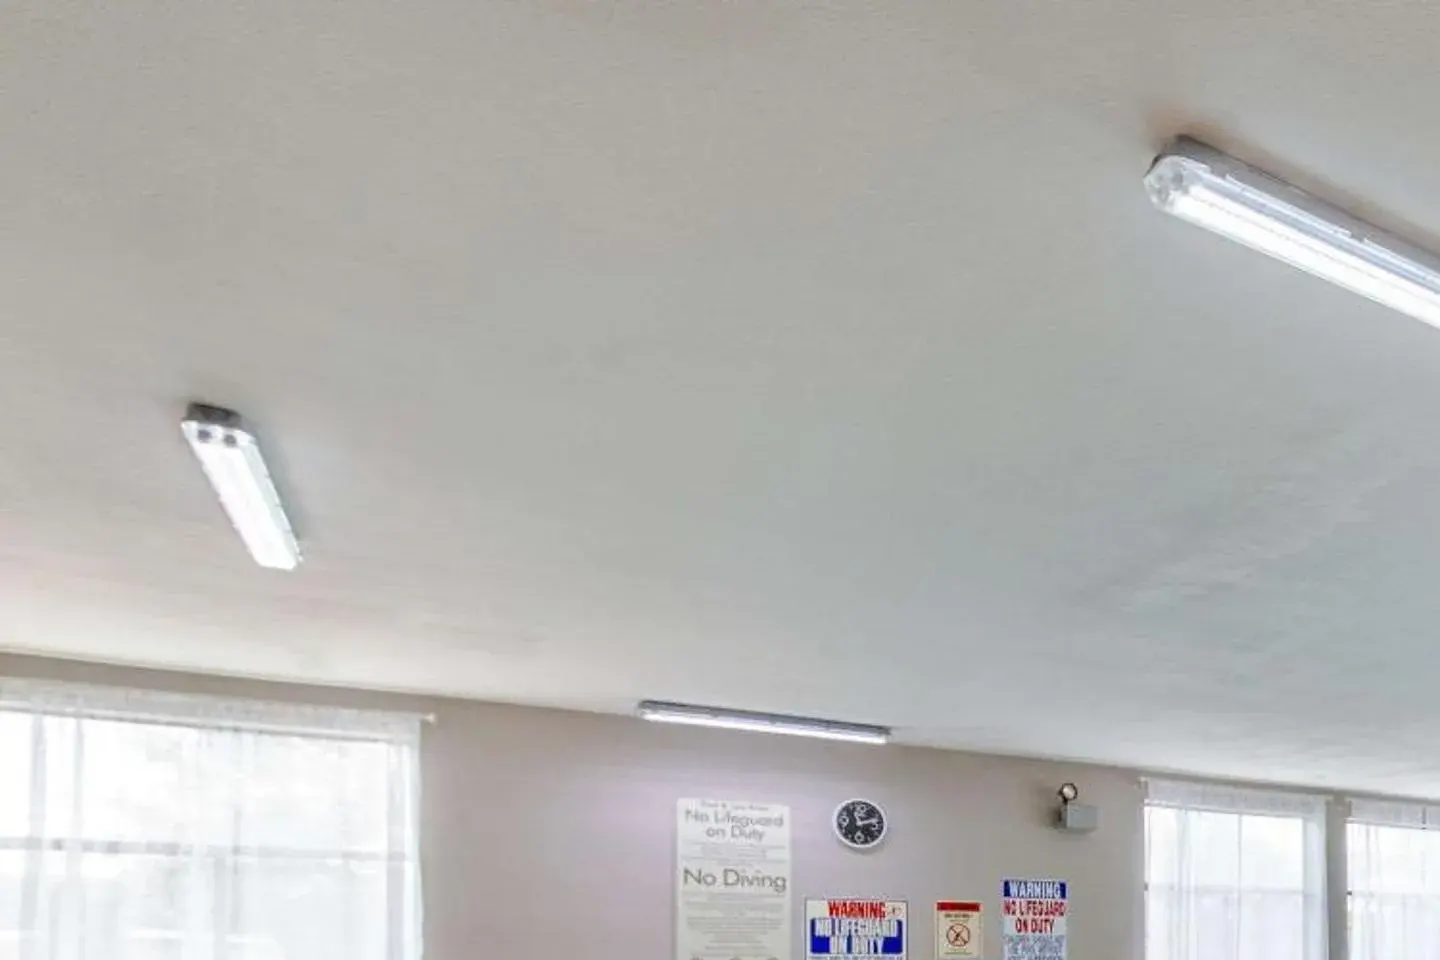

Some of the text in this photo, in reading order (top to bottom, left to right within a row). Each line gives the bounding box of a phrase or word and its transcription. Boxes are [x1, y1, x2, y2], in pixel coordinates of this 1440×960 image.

[706, 825, 764, 842] on Duty
[683, 868, 787, 893] No Diving
[1010, 881, 1061, 899] WARNING
[827, 901, 886, 918] WARNING
[1003, 900, 1065, 917] NO LIFEGUARD
[1015, 918, 1055, 934] ON DUTY
